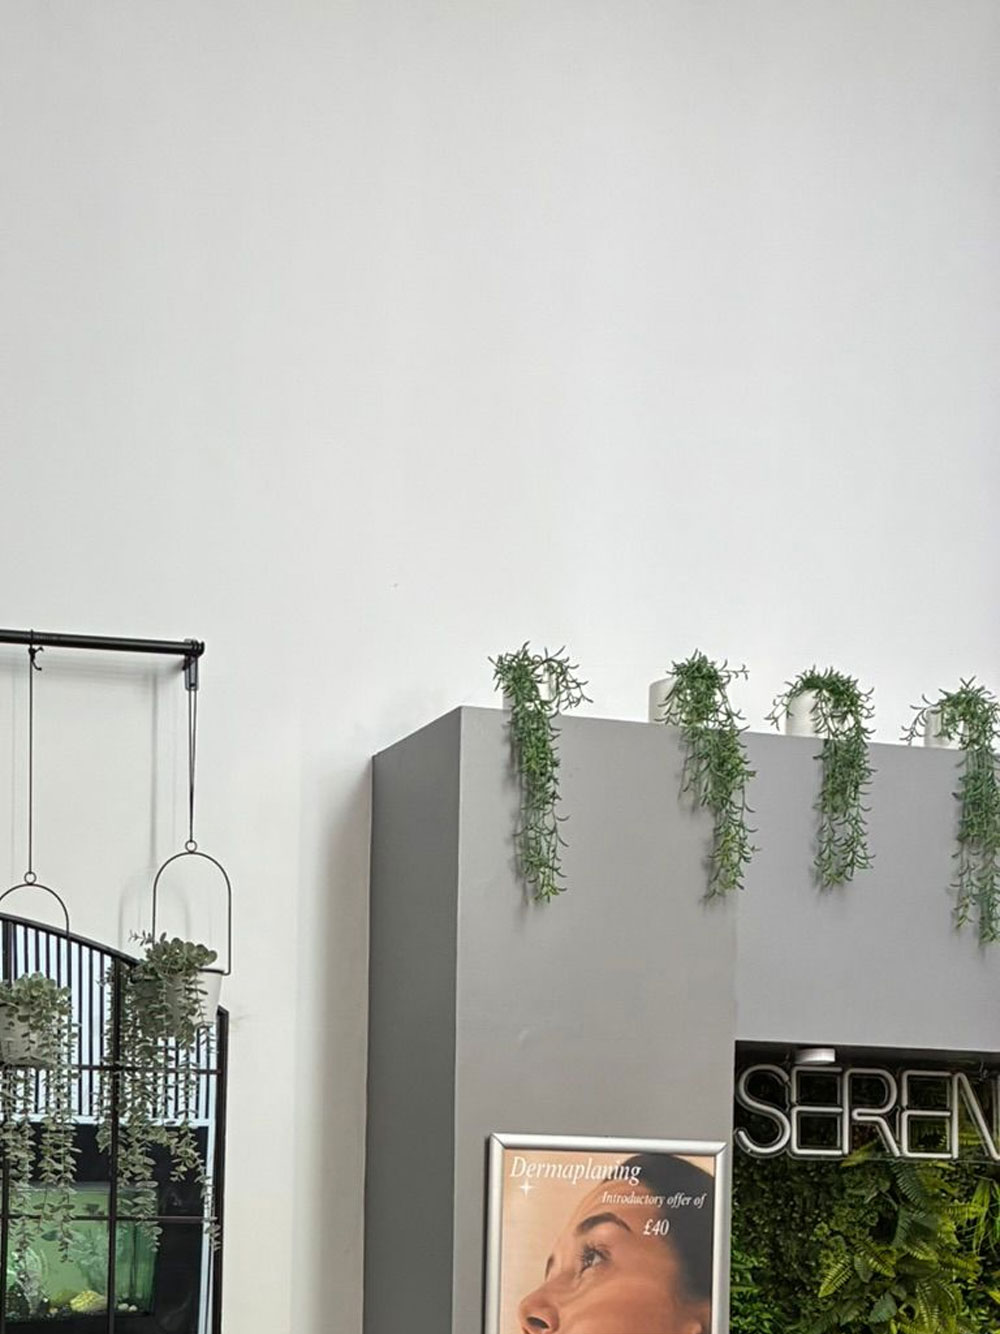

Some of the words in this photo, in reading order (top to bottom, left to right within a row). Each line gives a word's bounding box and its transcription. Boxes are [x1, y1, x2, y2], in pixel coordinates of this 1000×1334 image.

[510, 1155, 642, 1186] Dermaplaning
[602, 1190, 665, 1208] Introductory
[666, 1192, 692, 1209] offer
[693, 1193, 707, 1209] of
[643, 1218, 670, 1236] £40
